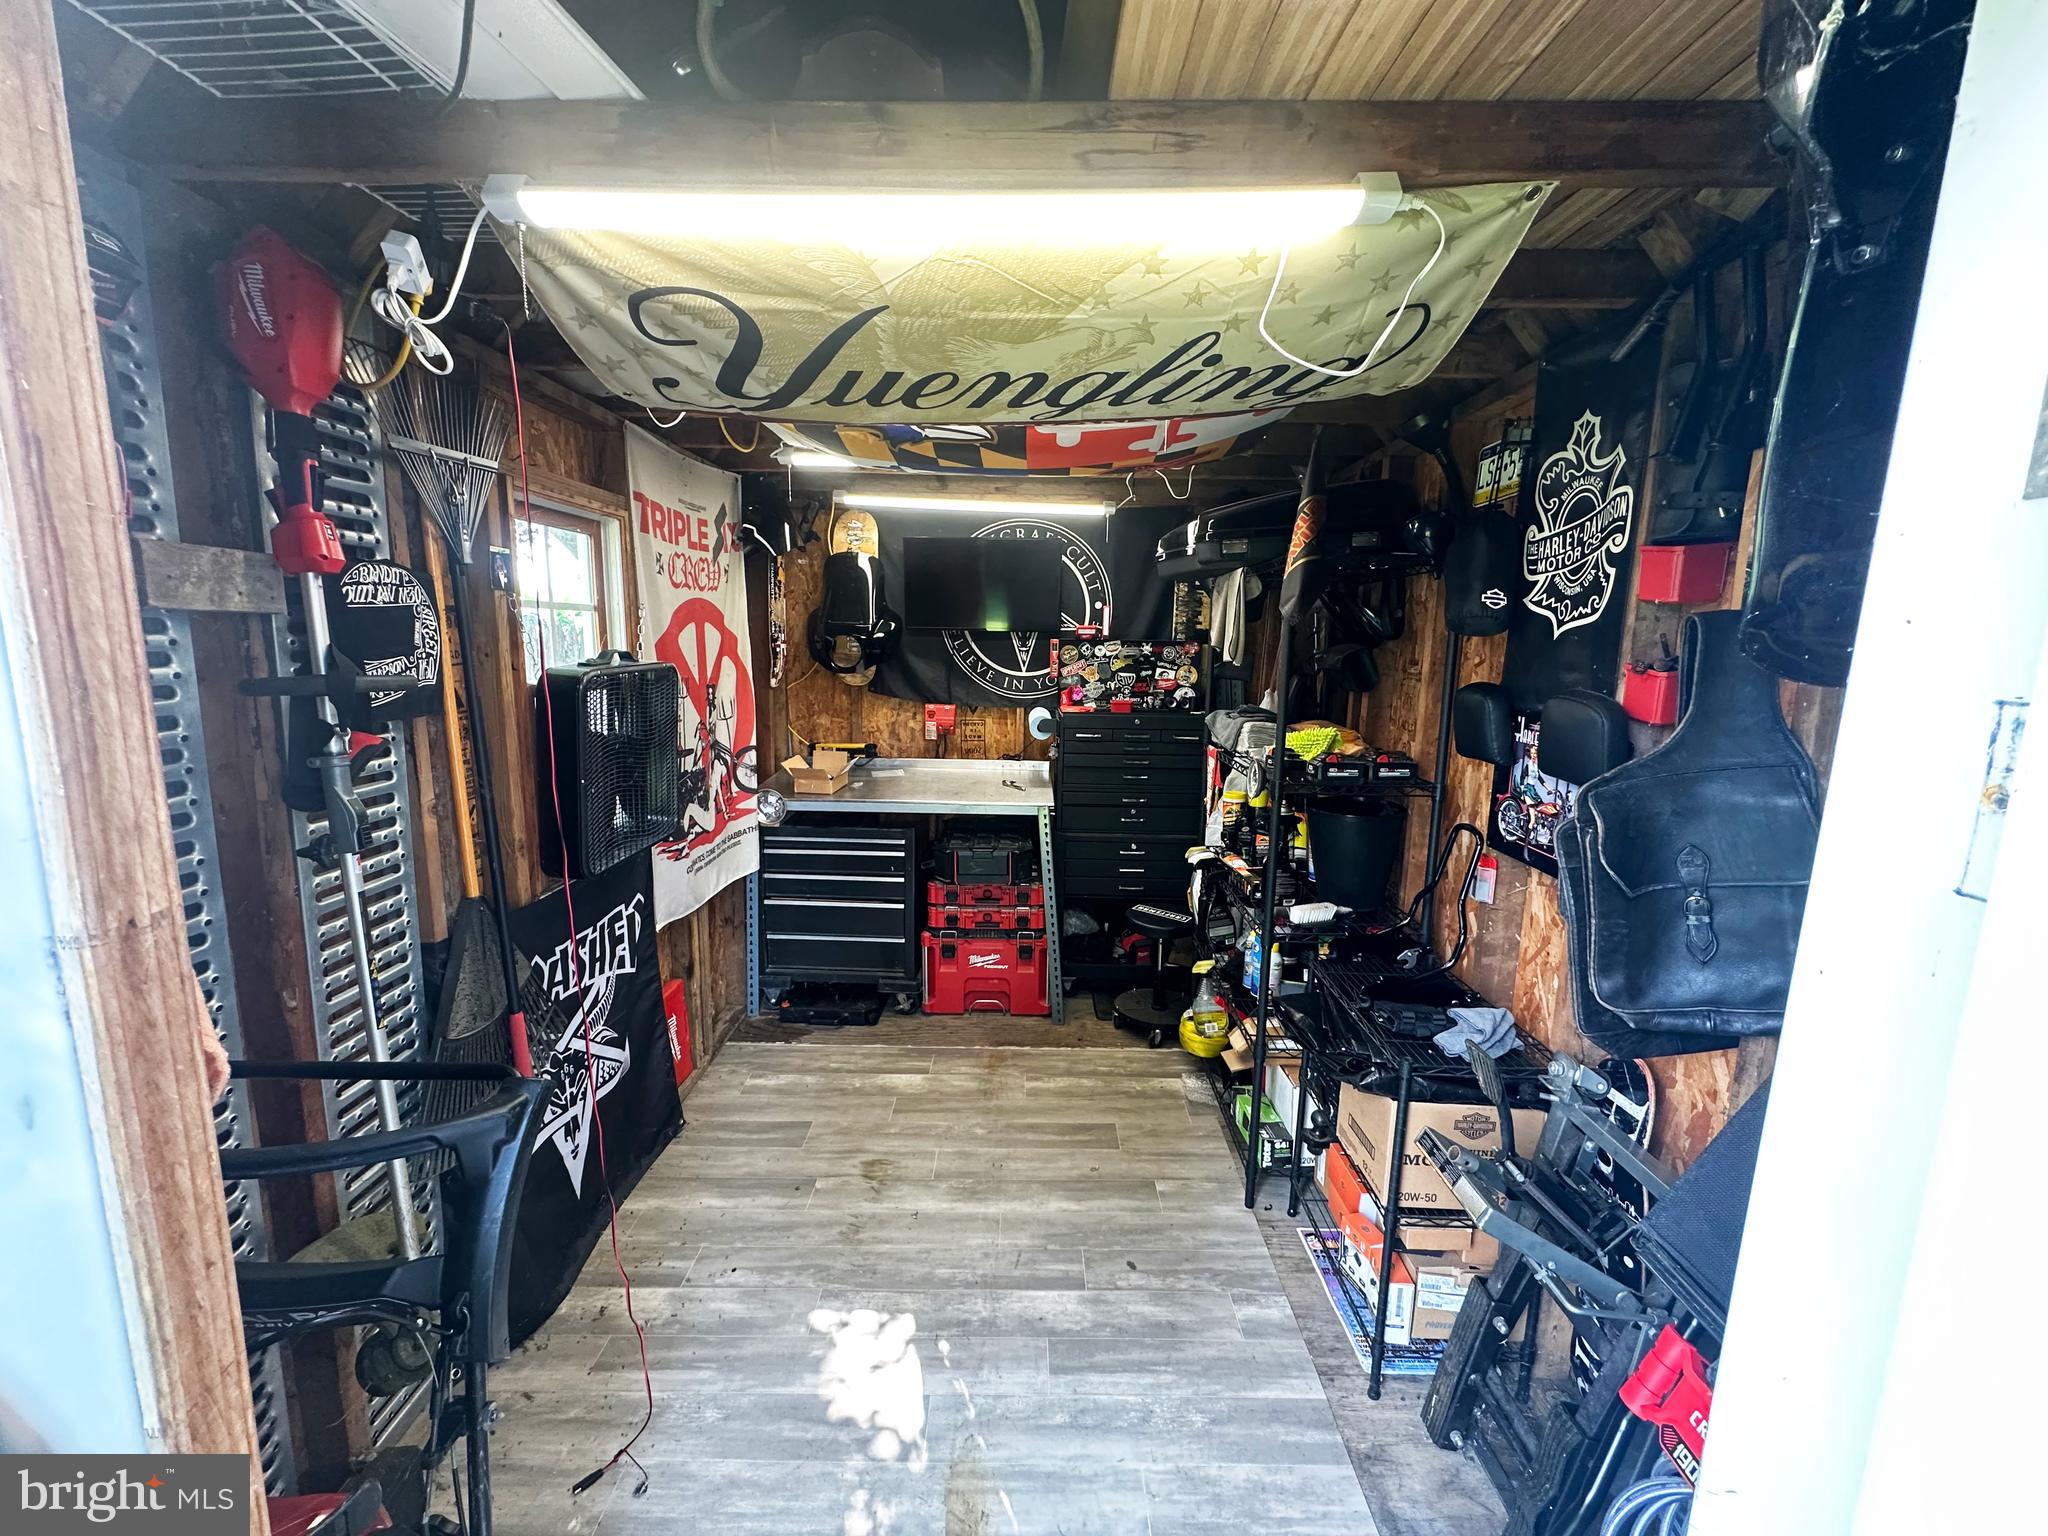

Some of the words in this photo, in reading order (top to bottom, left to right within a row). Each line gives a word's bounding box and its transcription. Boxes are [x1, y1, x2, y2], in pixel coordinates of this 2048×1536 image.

[243, 262, 276, 337] Milwaukee
[628, 285, 1433, 421] Yuengling
[1561, 475, 1604, 502] MILWAUKEE
[632, 490, 710, 553] TRIPLE
[1527, 544, 1538, 555] THE
[1537, 495, 1628, 559] HARLEY-DAVIDSON
[358, 564, 402, 585] BANDIT
[668, 551, 721, 592] CREW
[1067, 545, 1102, 592] CULT
[1536, 548, 1581, 573] MOTOR
[1584, 568, 1598, 587] USA
[952, 634, 996, 682] LIEVE
[1003, 676, 1025, 691] IN
[1514, 716, 1540, 746] HARLE
[968, 953, 1000, 965] Milwaukee
[667, 1012, 682, 1062] Milwaukee
[1262, 1139, 1272, 1168] Toter
[1399, 1192, 1437, 1202] 20W-50
